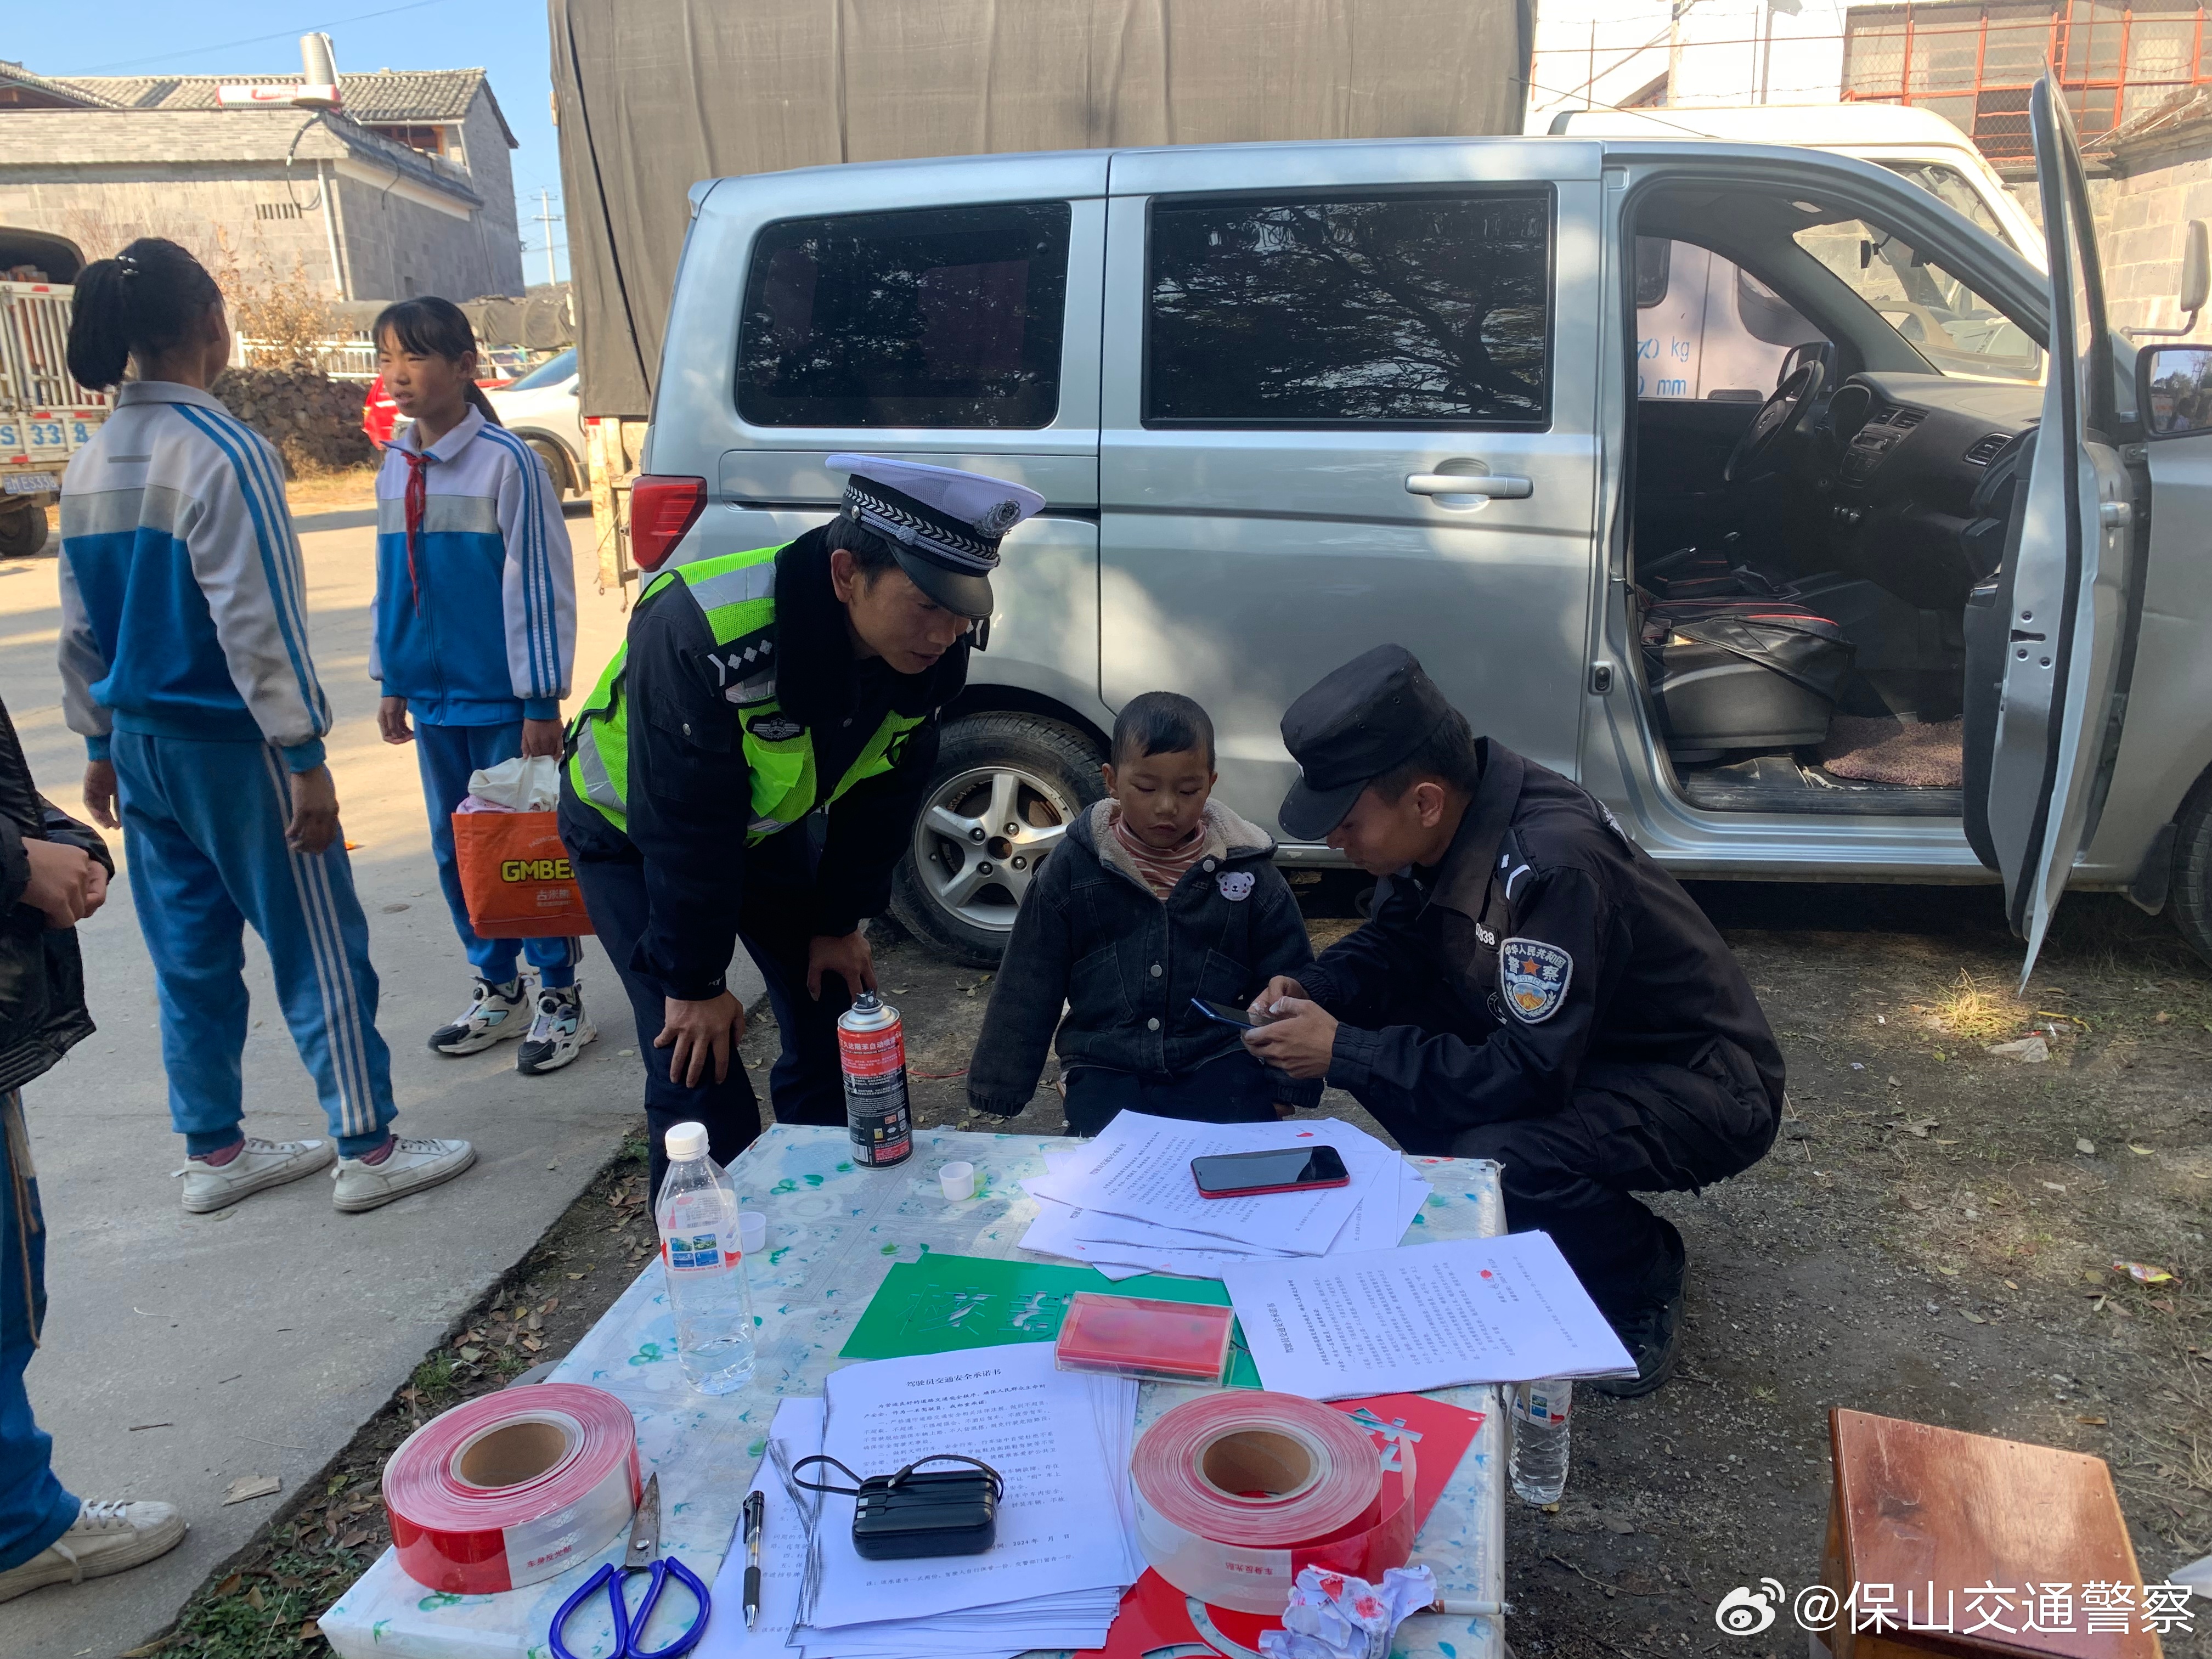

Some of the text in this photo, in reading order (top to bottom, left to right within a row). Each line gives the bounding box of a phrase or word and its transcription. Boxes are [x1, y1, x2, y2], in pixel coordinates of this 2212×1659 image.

[1671, 336, 1690, 363] kg
[1656, 379, 1686, 396] mm
[501, 857, 575, 882] GMBE
[1505, 944, 1567, 969] 中华人民共和国
[1516, 975, 1544, 987] POLICE
[906, 1368, 1001, 1387] 驾驶员交通安全承诺书
[527, 1545, 572, 1568] 车身反光贴
